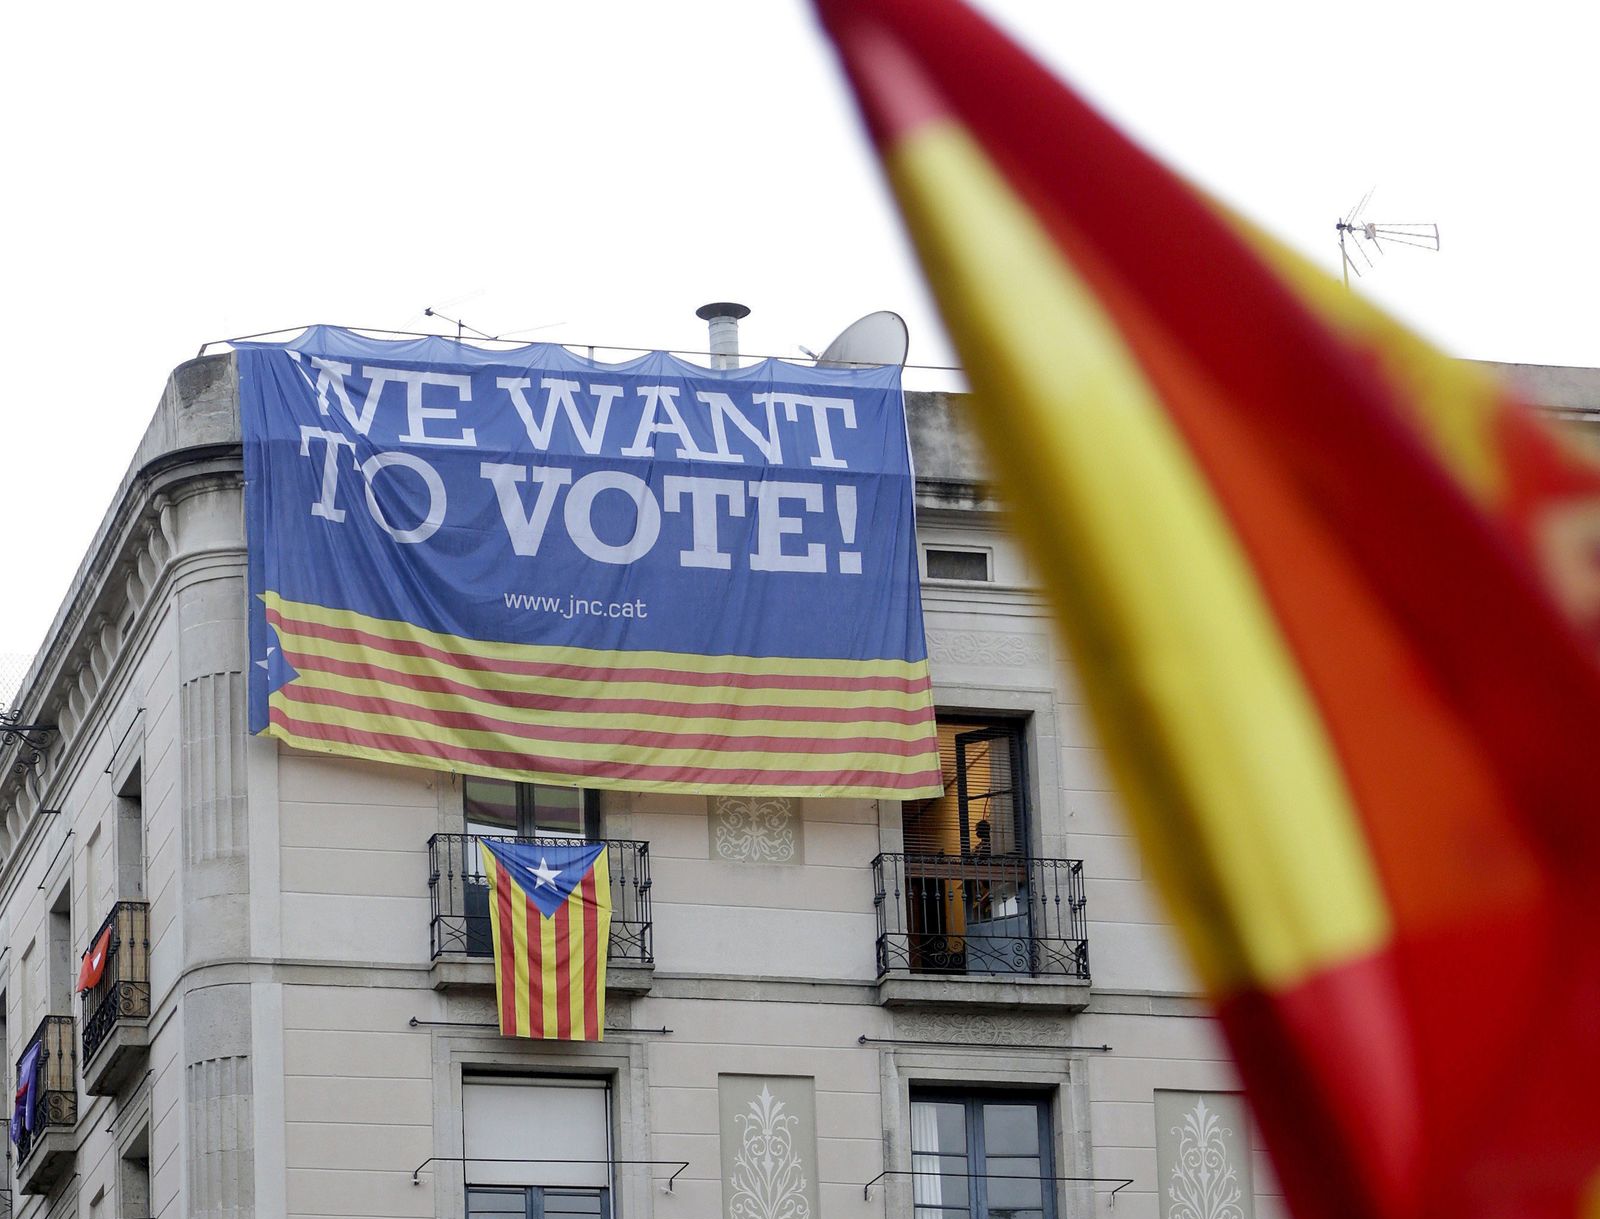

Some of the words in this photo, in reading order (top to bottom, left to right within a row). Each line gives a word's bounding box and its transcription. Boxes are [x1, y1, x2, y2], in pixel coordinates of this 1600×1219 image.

[287, 351, 477, 447] WE
[496, 376, 858, 469] WANT
[299, 424, 448, 544] TO
[479, 461, 863, 575] VOTE!
[503, 592, 649, 619] www.jnc.cat
